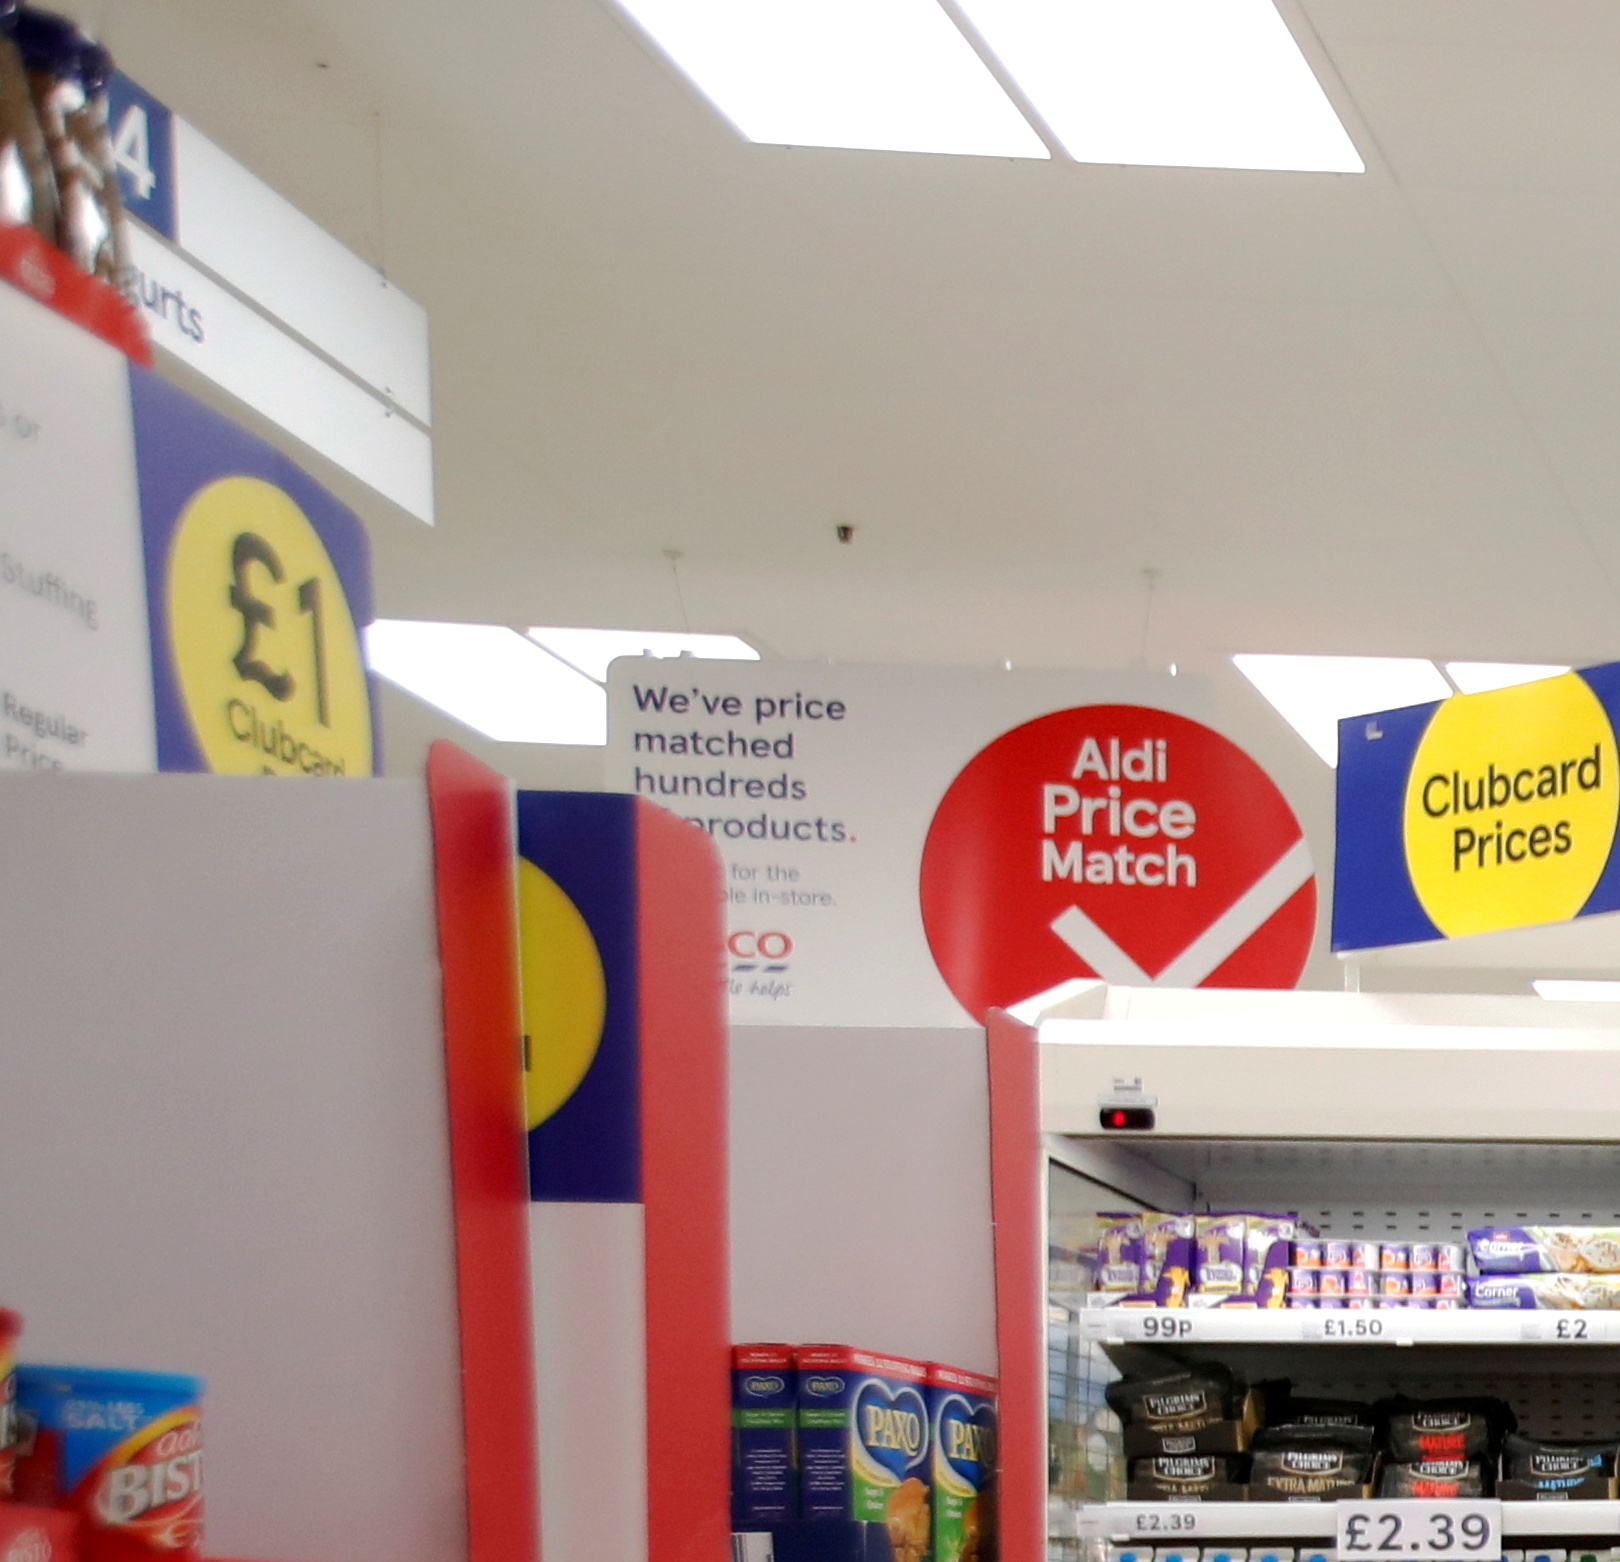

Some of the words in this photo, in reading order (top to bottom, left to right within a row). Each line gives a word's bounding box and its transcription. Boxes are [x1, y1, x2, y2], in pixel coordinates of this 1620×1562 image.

[228, 532, 329, 728] £1
[3, 690, 88, 747] Regular
[755, 691, 847, 724] price
[226, 698, 346, 775] Clubcard
[634, 727, 795, 759] matched
[1072, 739, 1168, 783] Aldi
[635, 767, 807, 800] hundreds
[1422, 744, 1602, 820] Clubcard
[1042, 785, 1197, 839] Price
[1041, 840, 1197, 888] Match
[1452, 821, 1572, 872] Prices
[731, 864, 761, 881] for
[768, 865, 800, 882] the
[753, 887, 838, 906] in-store.
[1479, 1239, 1524, 1253] Corner
[1475, 1284, 1519, 1299] Corner
[1143, 1317, 1192, 1339] 99p
[1324, 1319, 1383, 1338] £1.50
[1556, 1319, 1588, 1340] £2
[866, 1403, 921, 1458] PAXO
[104, 1452, 200, 1522] BIST
[1136, 1514, 1197, 1531] £2.39
[1345, 1513, 1491, 1552] £2.39
